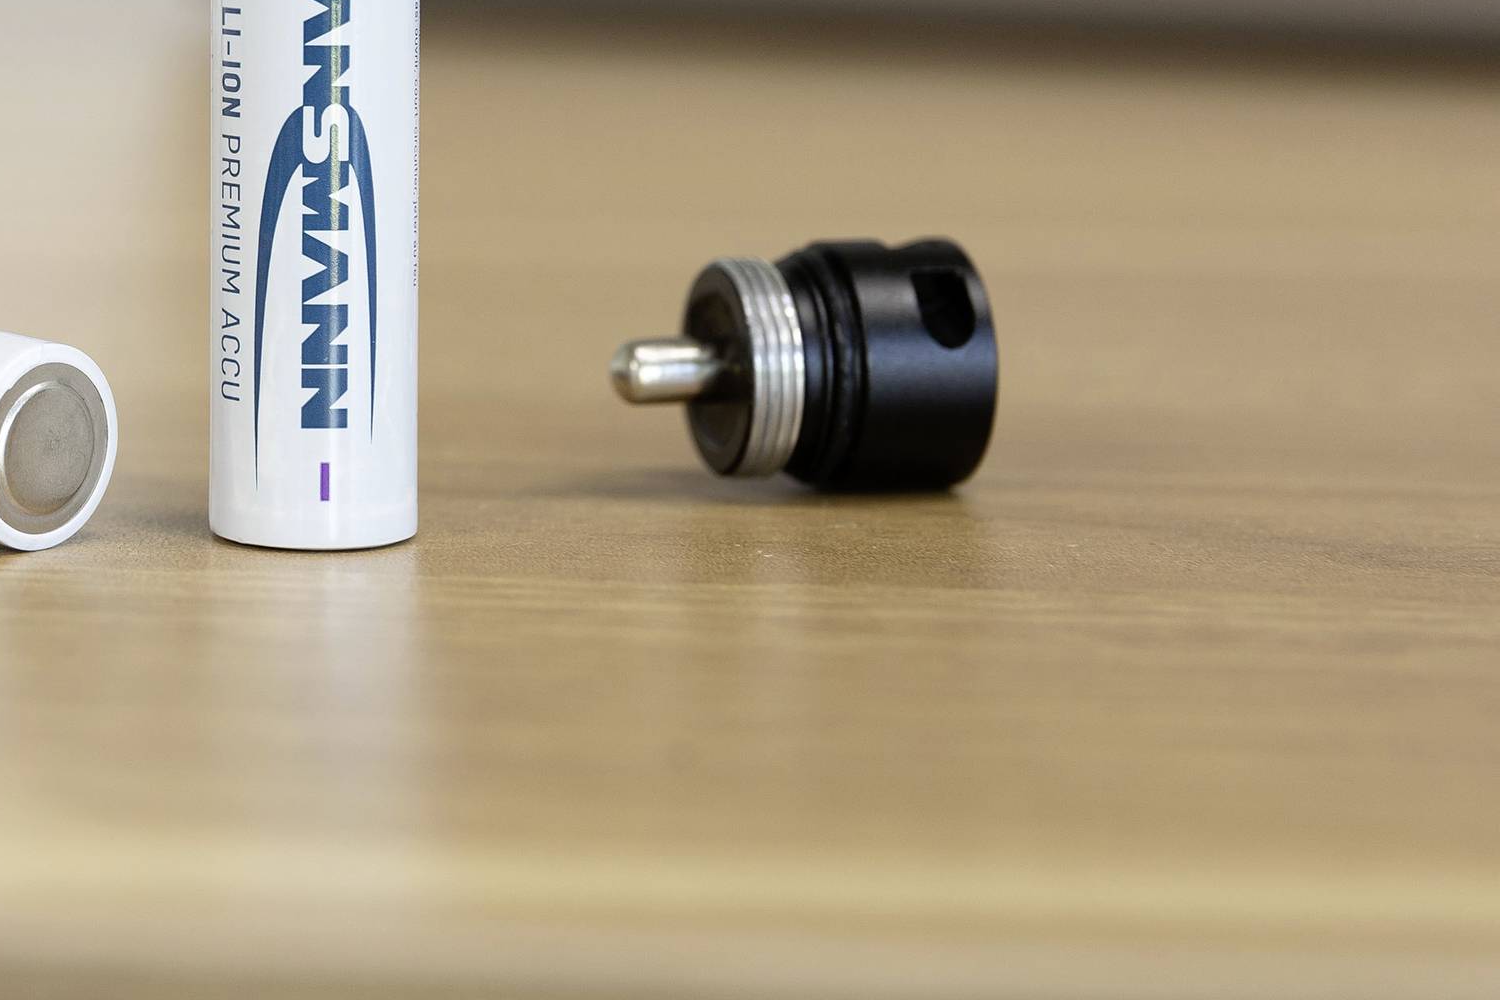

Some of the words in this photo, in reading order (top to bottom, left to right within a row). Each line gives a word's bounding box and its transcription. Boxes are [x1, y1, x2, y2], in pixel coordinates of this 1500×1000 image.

[221, 6, 241, 118] LI-ION
[221, 133, 241, 295] PREMIUM
[221, 307, 241, 402] ACCU
